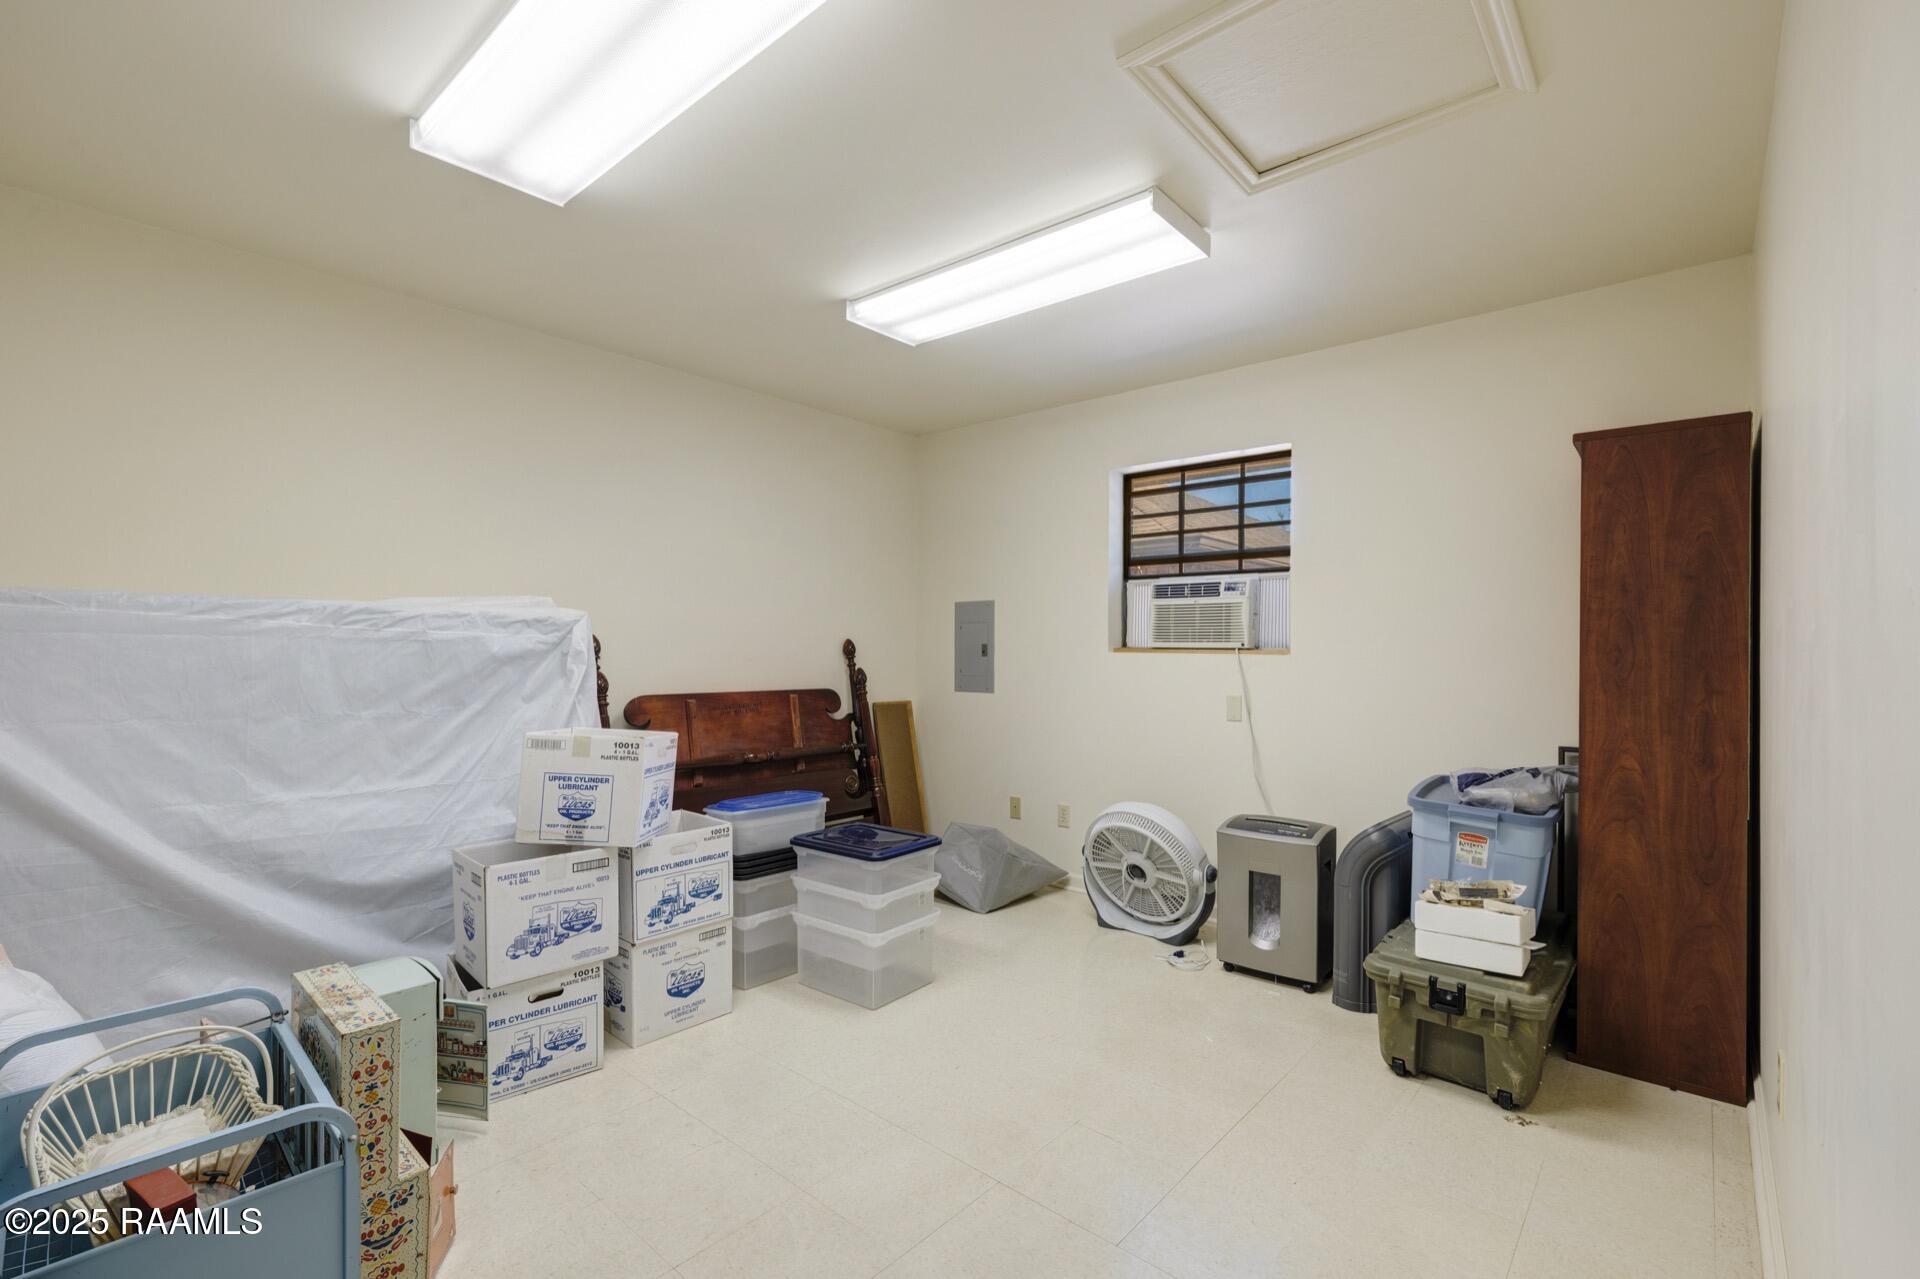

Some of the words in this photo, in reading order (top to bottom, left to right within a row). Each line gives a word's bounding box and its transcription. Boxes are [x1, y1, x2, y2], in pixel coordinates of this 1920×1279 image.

[614, 742, 640, 750] 10013
[574, 776, 610, 784] CYLINDER
[561, 800, 595, 808] LUCAS
[711, 827, 730, 836] 10013
[636, 866, 660, 876] UPPER
[660, 859, 694, 872] CYLINDER
[694, 851, 730, 864] LUBRICANT
[497, 872, 518, 882] PLASTIC
[519, 869, 541, 878] BOTTLES
[538, 890, 552, 898] THAT
[554, 886, 575, 896] ENGINE
[573, 966, 600, 979] 10013
[580, 974, 601, 983] BOTTLES
[488, 1018, 506, 1028] PER
[508, 1007, 551, 1024] CYLINDER
[553, 994, 598, 1012] LUBRICANT
